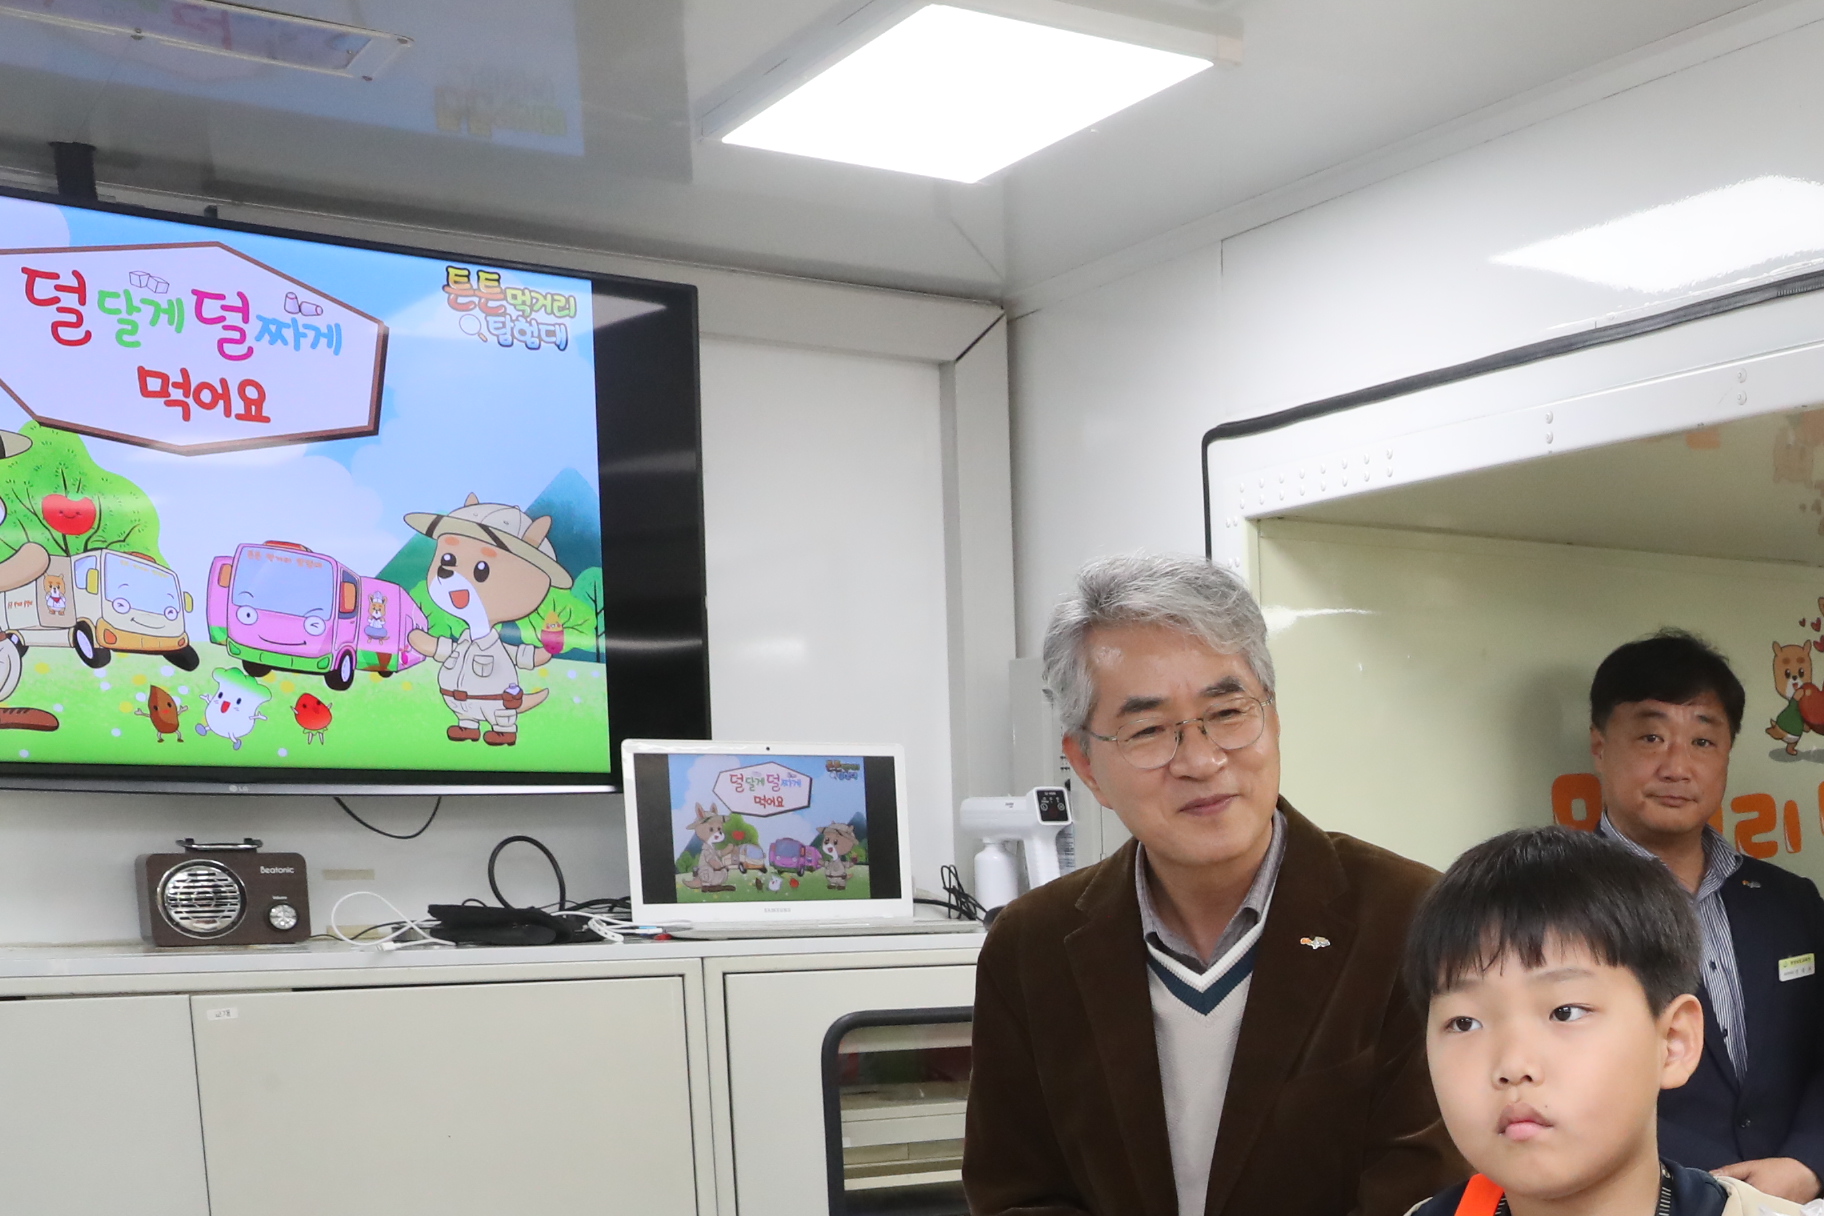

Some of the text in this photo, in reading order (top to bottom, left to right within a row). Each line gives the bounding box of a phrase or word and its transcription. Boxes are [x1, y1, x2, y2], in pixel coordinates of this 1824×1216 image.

[21, 266, 342, 361] 덜 달게 덜 짜게
[442, 265, 576, 318] 튼튼 먹거리
[485, 314, 568, 351] 탐험대
[137, 366, 271, 422] 먹어요
[753, 795, 785, 808] 먹어요
[260, 866, 295, 874] Beatonic
